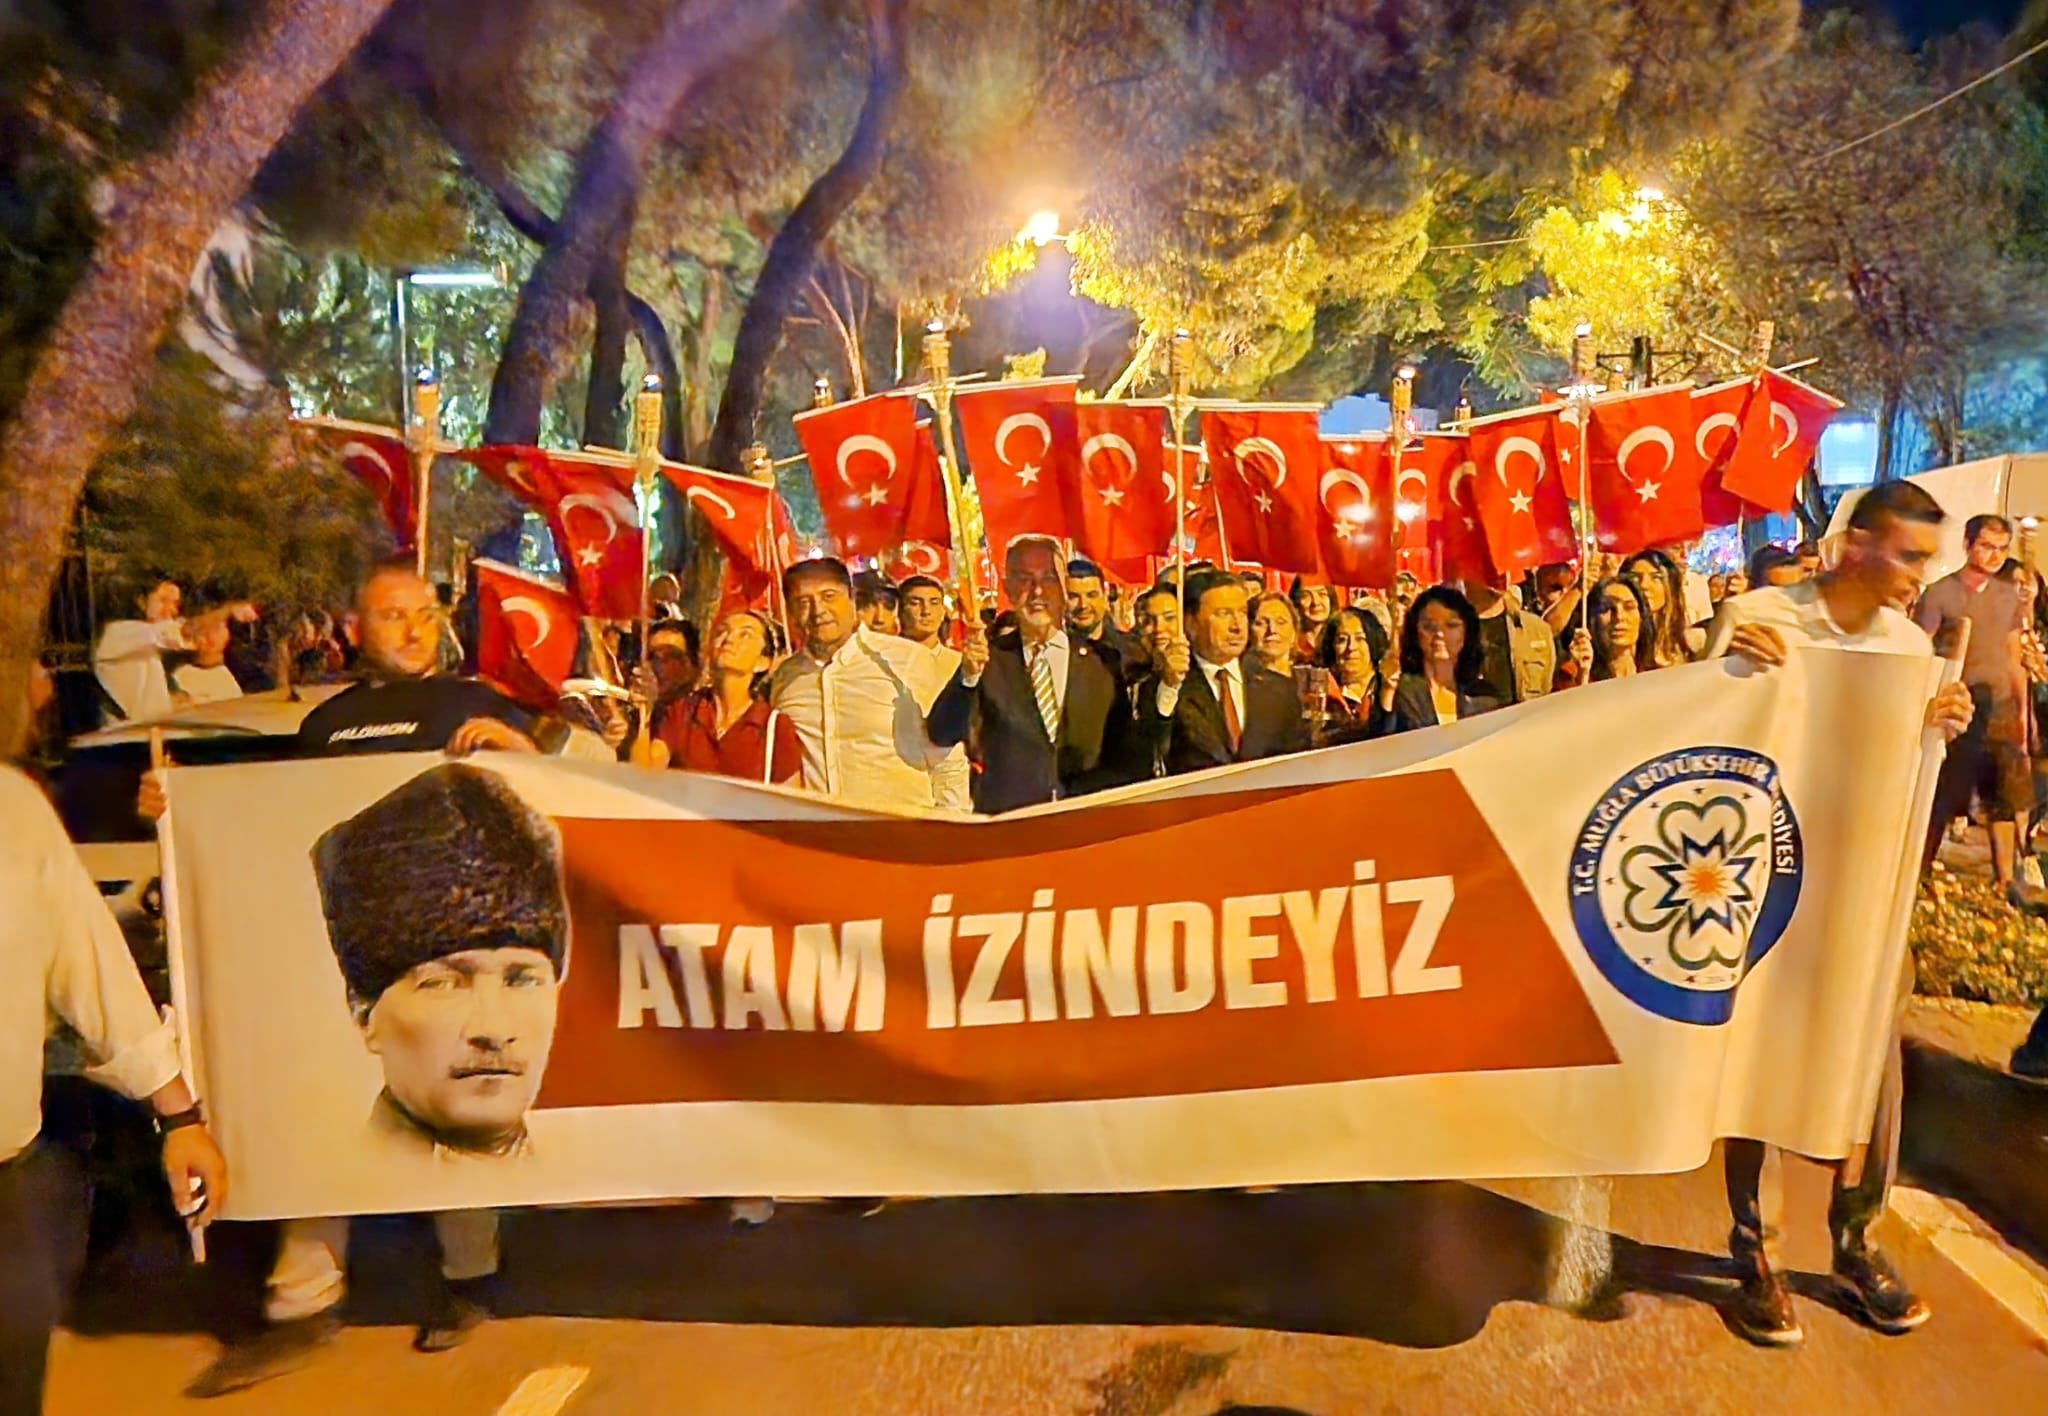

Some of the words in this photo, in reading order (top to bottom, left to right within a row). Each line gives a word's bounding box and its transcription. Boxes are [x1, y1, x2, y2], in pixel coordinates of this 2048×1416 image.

[1634, 753, 1771, 791] BÜYÜKŞEHİR
[1580, 786, 1640, 854] MUĞLA
[1573, 859, 1597, 896] T.C.
[617, 918, 886, 1033] ATAM
[922, 858, 1463, 1029] İZİNDEYİZ
